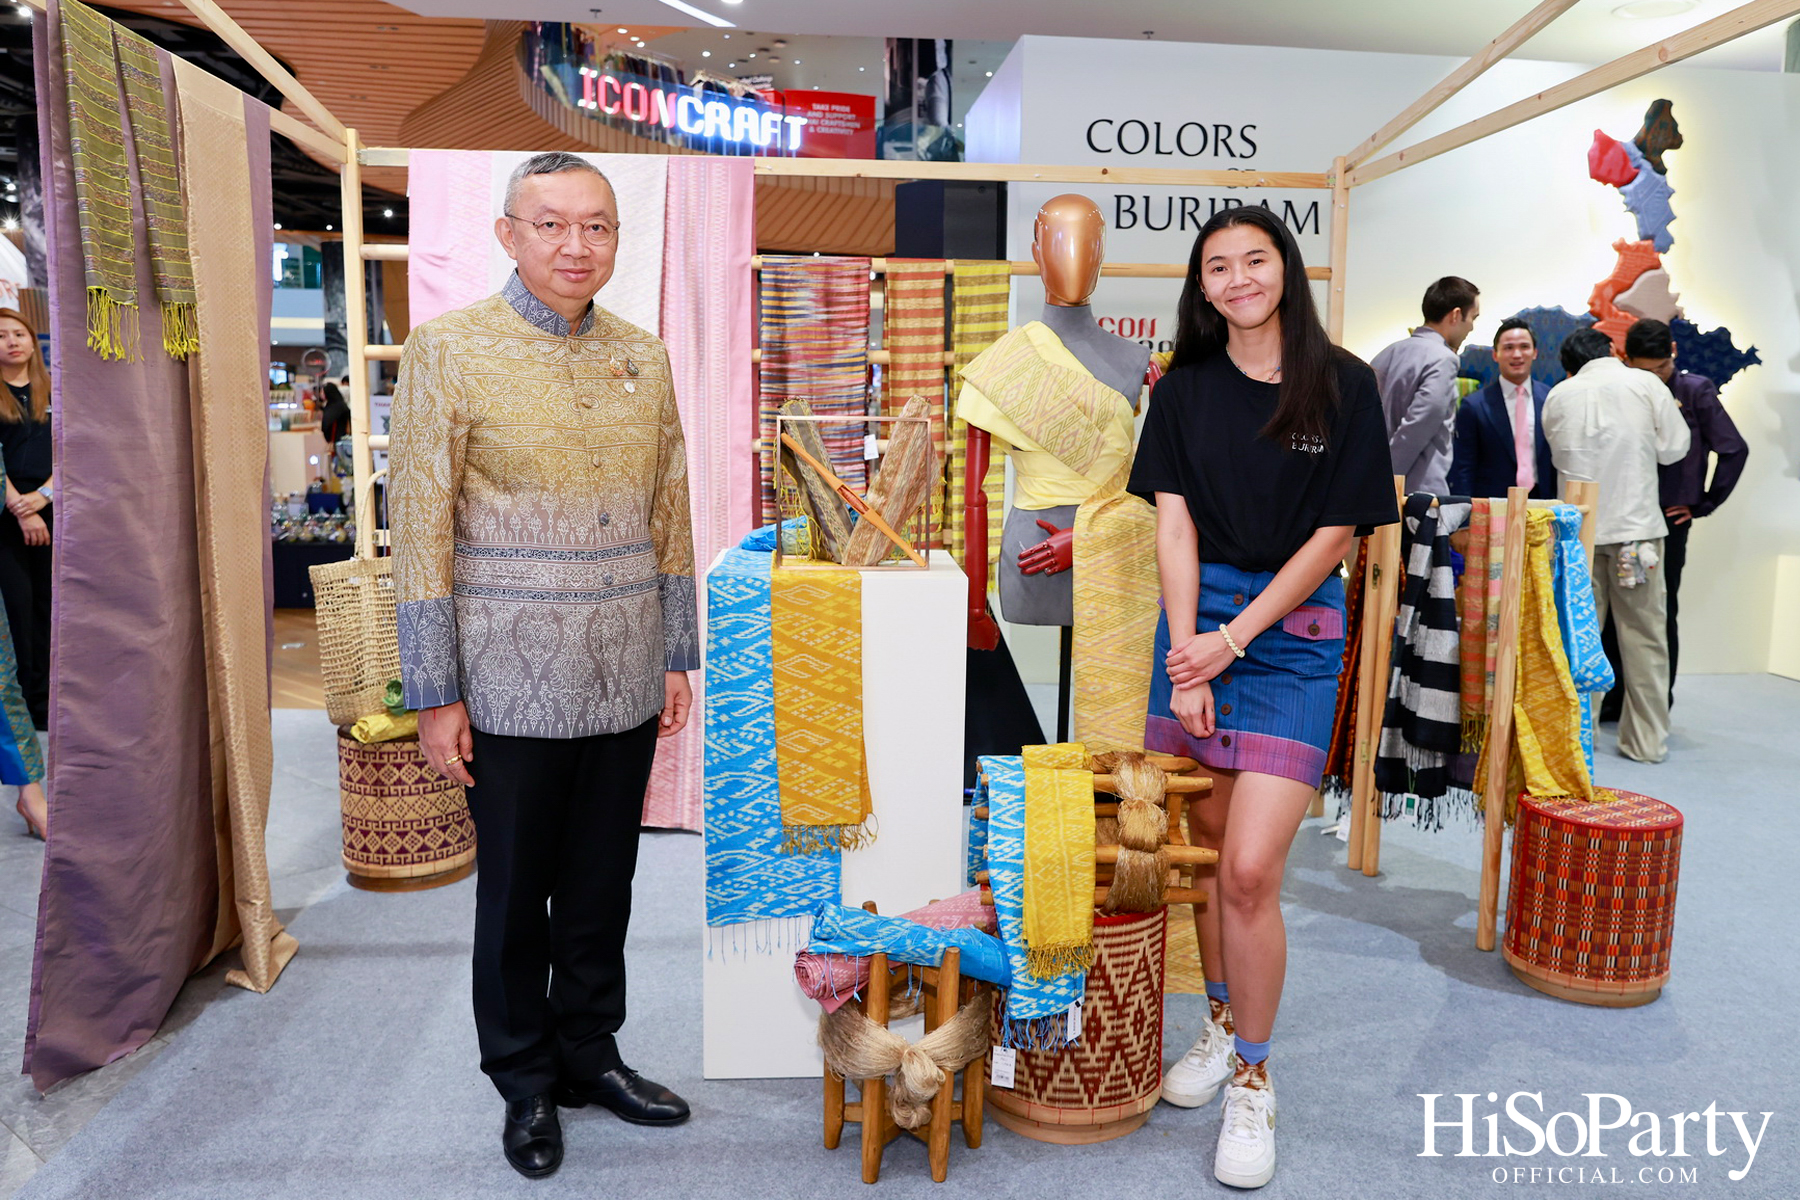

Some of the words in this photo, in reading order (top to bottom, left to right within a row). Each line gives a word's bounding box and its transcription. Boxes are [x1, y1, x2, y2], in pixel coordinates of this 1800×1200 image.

[812, 103, 829, 111] TAKE
[831, 104, 851, 113] PRIDE
[825, 112, 857, 120] SUPPORT
[820, 119, 861, 129] CRAFTSMEN
[817, 126, 854, 135] CREATIVITY
[1086, 119, 1257, 159] COLORS
[1095, 317, 1157, 338] CON
